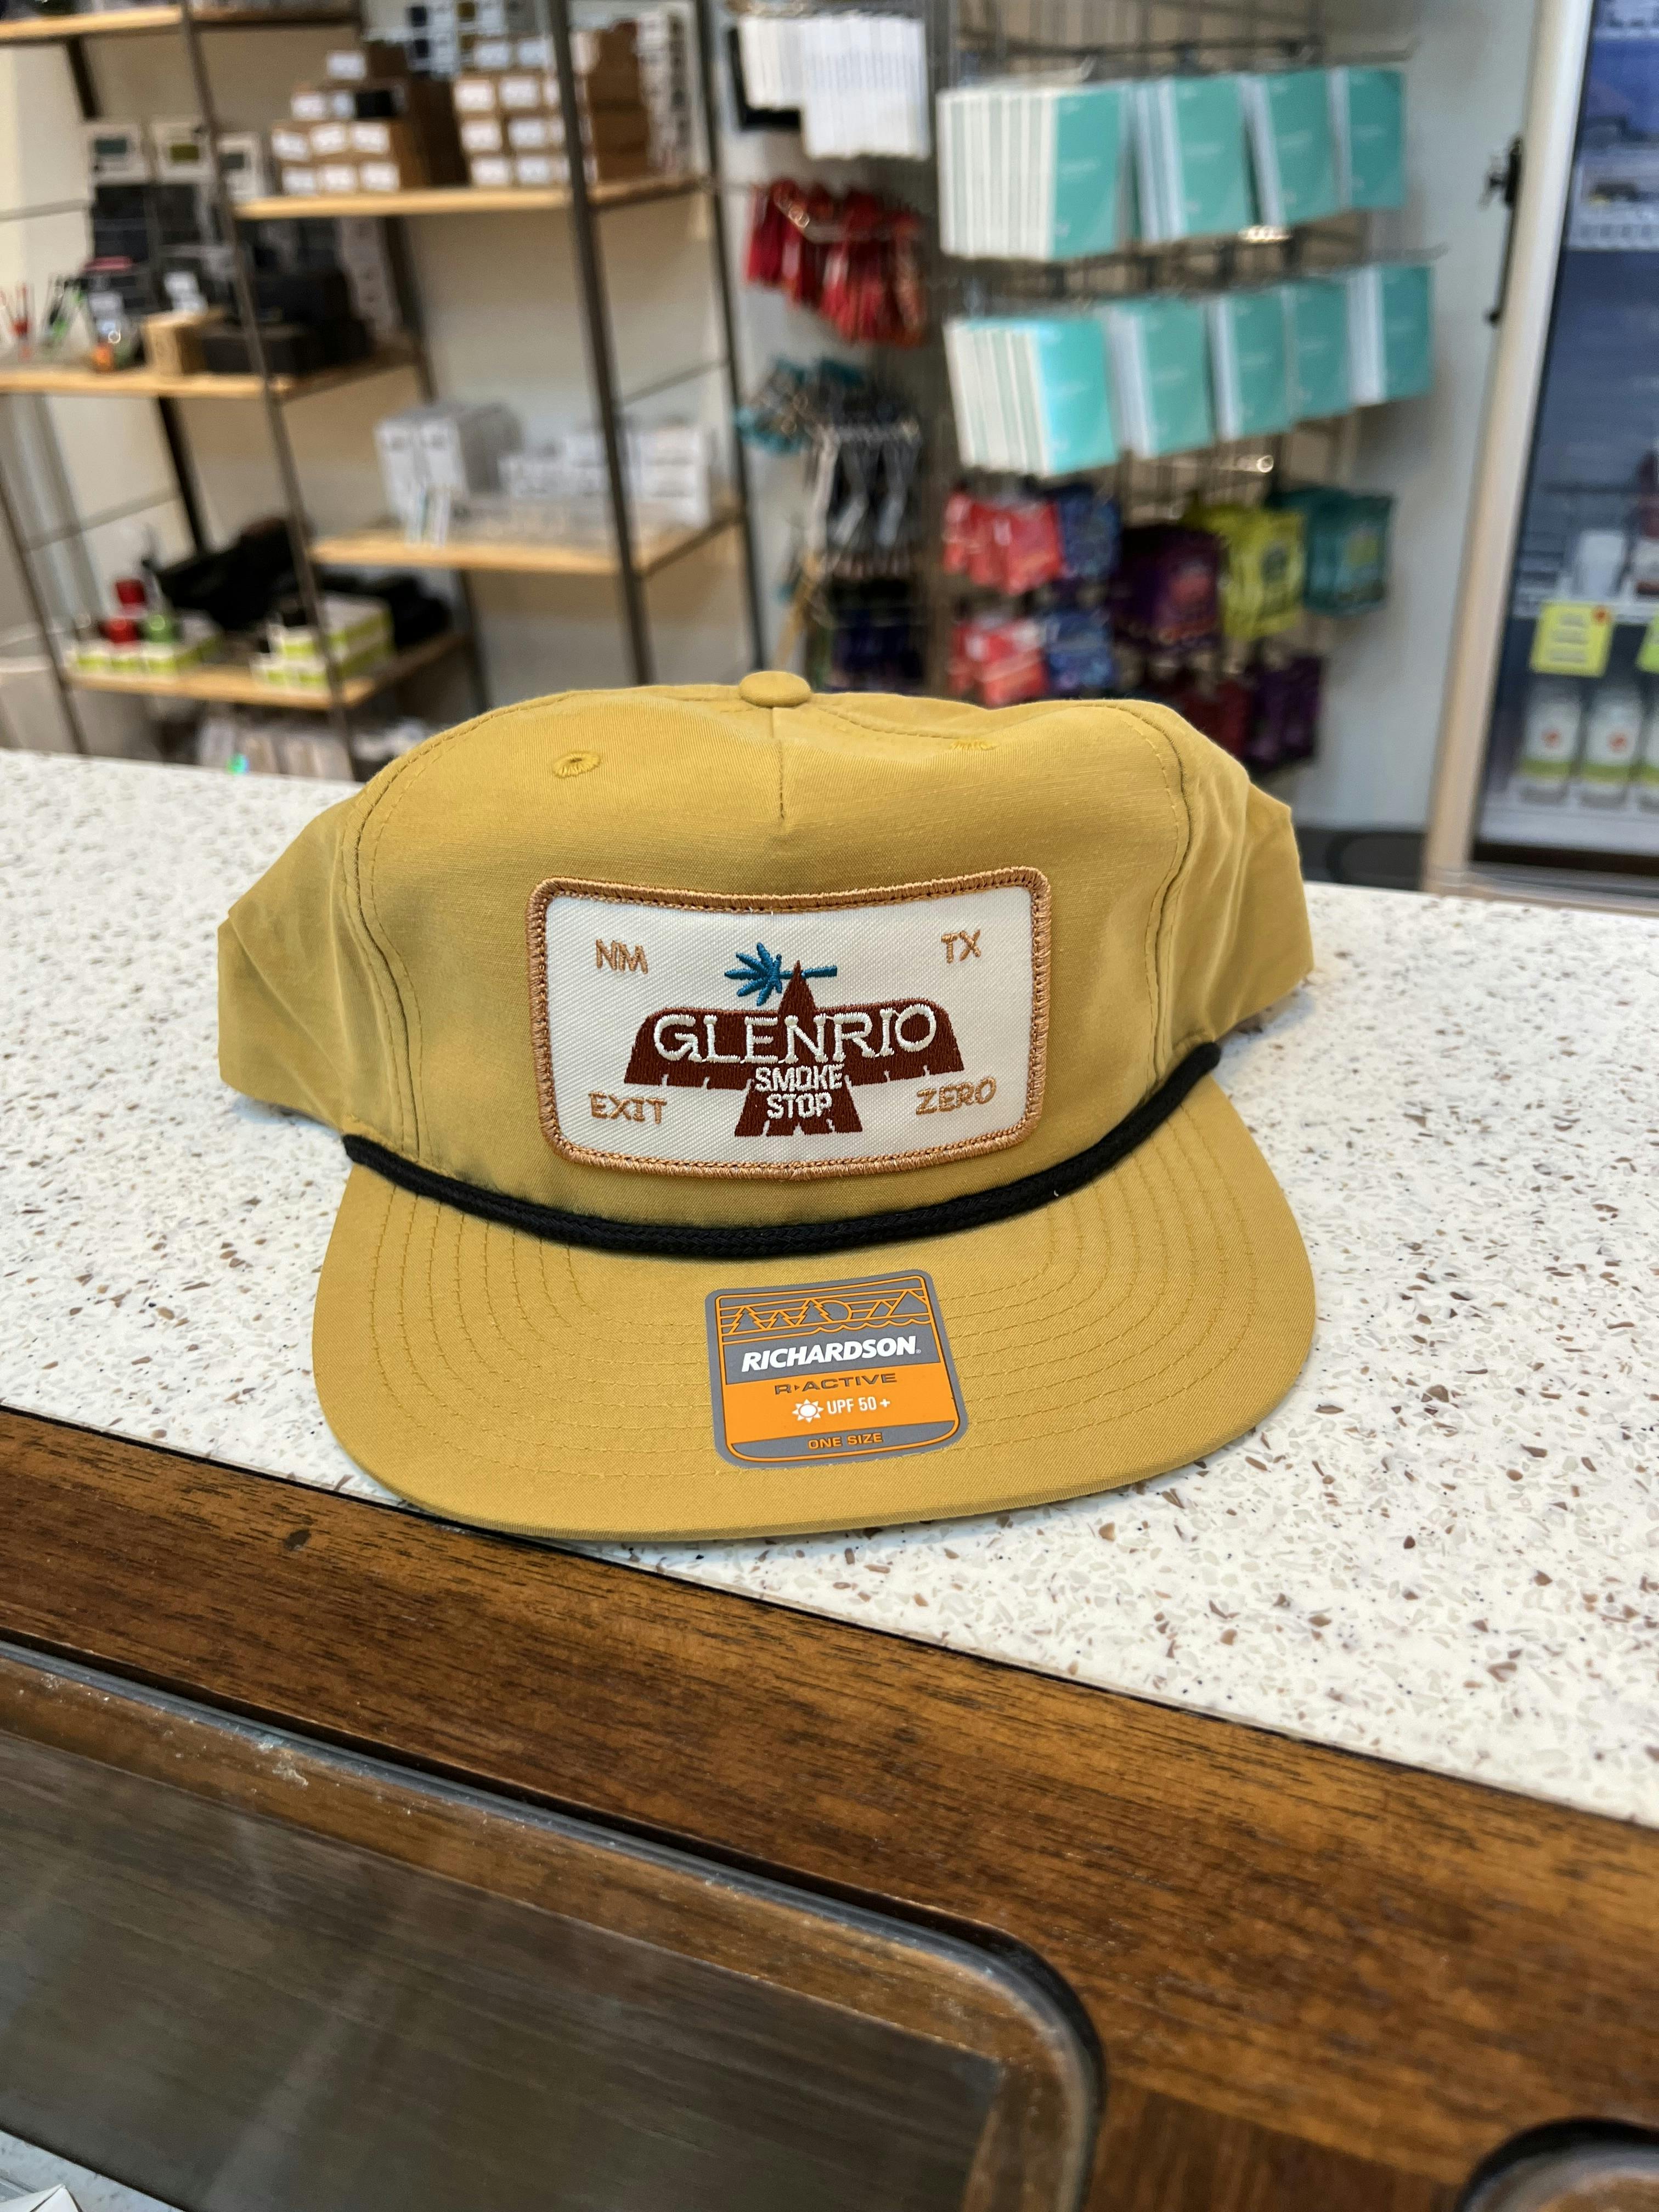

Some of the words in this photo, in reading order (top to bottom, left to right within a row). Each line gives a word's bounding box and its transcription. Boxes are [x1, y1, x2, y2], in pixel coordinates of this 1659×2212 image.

[595, 939, 649, 974] NM
[941, 929, 982, 963] TX
[653, 1003, 937, 1064] GLENRIO
[754, 1063, 844, 1092] SMOKE
[588, 1091, 667, 1124] EXIT
[767, 1092, 832, 1118] STOP
[916, 1077, 997, 1115] ZERO
[827, 1397, 854, 1415] UPF
[808, 1437, 843, 1450] ONE
[847, 1432, 884, 1445] SIZE
